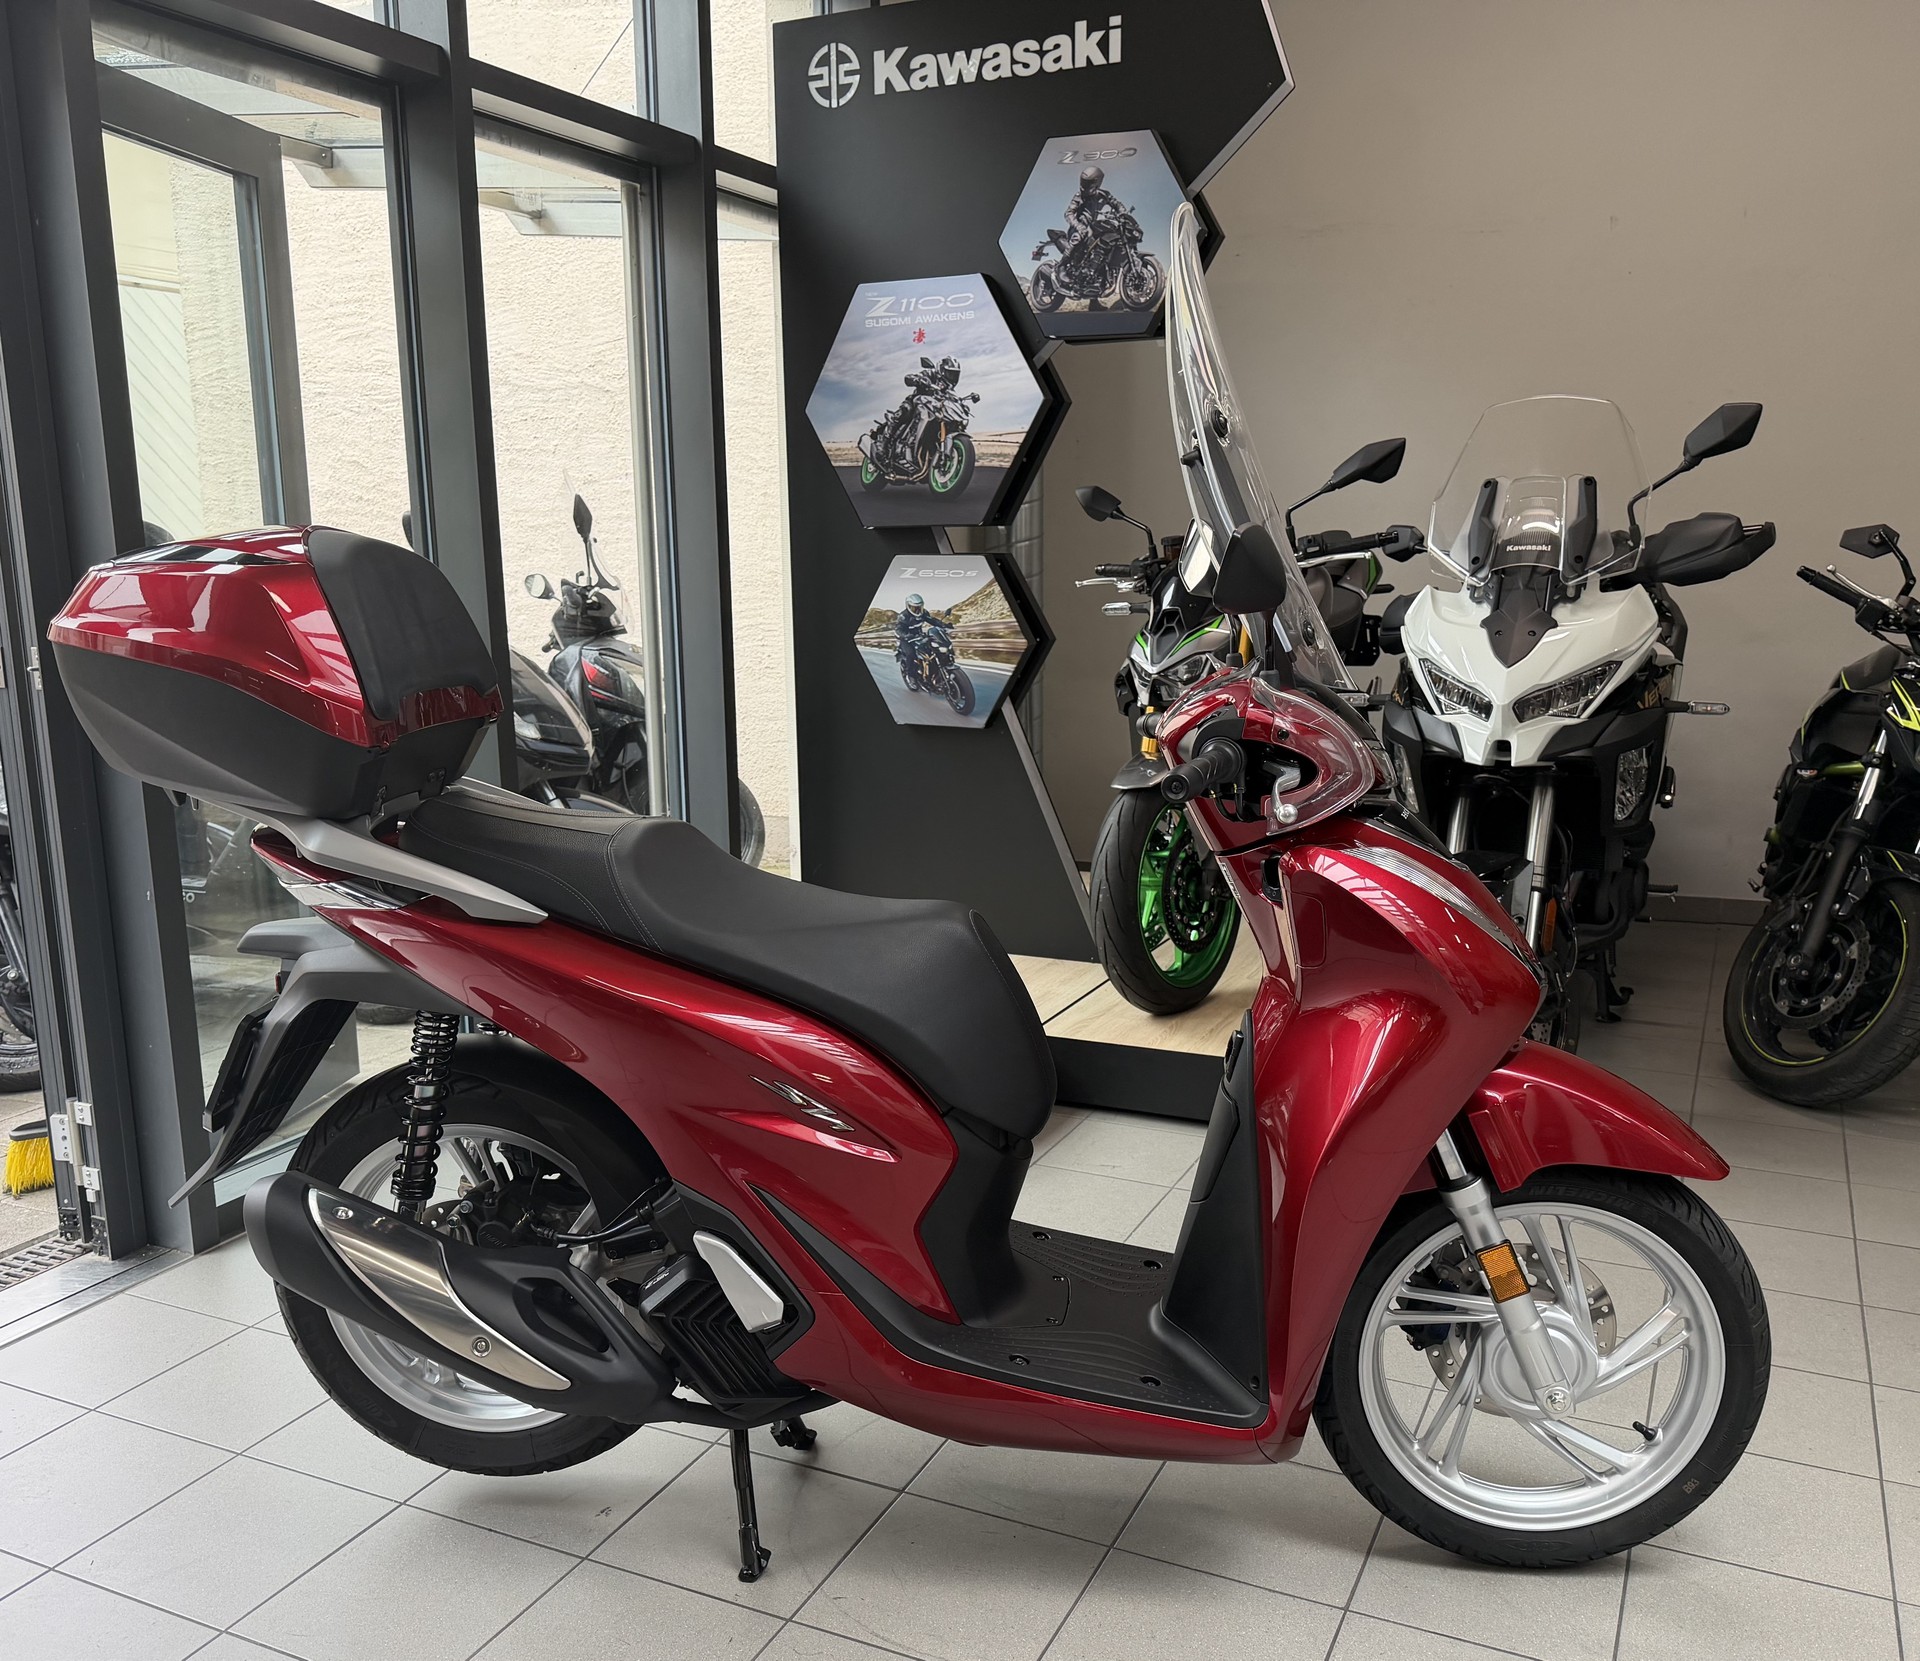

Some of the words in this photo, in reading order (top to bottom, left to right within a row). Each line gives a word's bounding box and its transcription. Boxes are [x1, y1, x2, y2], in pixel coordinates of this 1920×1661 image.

[873, 15, 1122, 95] Kawasaki
[865, 316, 911, 328] SUGOMI
[915, 310, 975, 324] AWAKENS
[1506, 544, 1552, 552] Kawasaki
